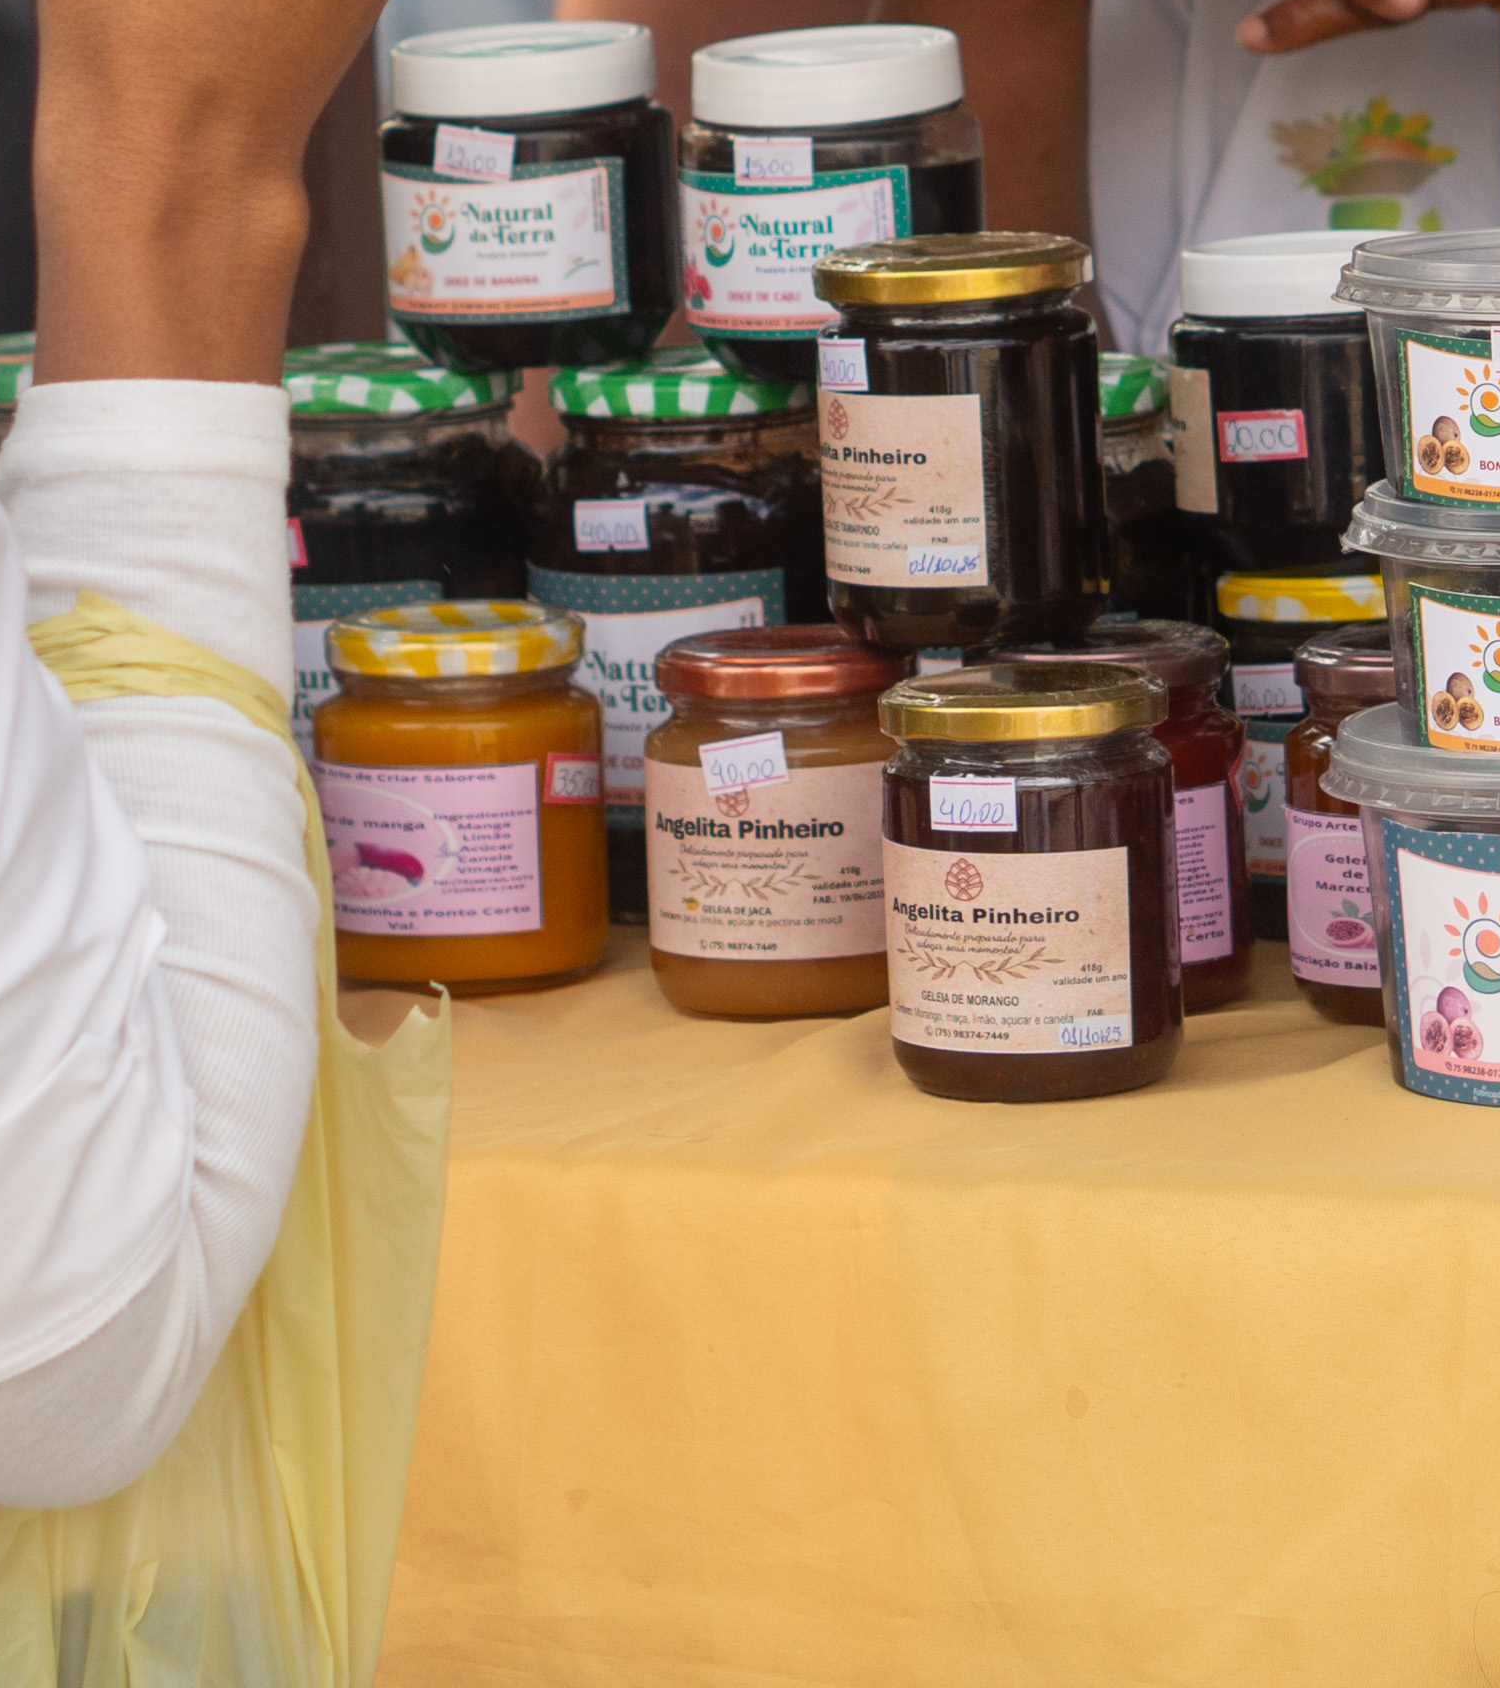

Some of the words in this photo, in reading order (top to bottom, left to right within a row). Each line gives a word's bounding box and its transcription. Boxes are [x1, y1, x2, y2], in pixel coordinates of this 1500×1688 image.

[741, 156, 794, 179] 15,00
[461, 202, 553, 224] Natural
[740, 214, 834, 236] Natural
[470, 228, 487, 242] da
[491, 225, 555, 245] Terra
[749, 243, 766, 257] da
[842, 447, 927, 465] Pinheiro
[424, 773, 496, 782] Sabores
[710, 759, 774, 785] 40,00
[940, 798, 1005, 828] 40,00
[363, 820, 425, 831] manga
[656, 812, 731, 840] Angelita
[739, 819, 844, 839] Pinheiro
[1326, 821, 1357, 831] Arte
[1325, 853, 1366, 865] Gelei
[1342, 869, 1363, 879] de
[483, 904, 530, 915] Certo
[734, 907, 746, 915] DE
[748, 907, 772, 917] JACA
[893, 897, 964, 923] Angelita
[973, 908, 1080, 924] Pinheiro
[964, 932, 1018, 944] preparado
[1020, 934, 1046, 943] para
[1186, 929, 1224, 943] Certo
[1081, 964, 1103, 973] 418g
[1053, 976, 1093, 986] validade
[1112, 973, 1127, 981] ano
[921, 990, 949, 1003] GELEIA
[952, 994, 964, 1004] DE
[967, 995, 1019, 1006] MORANGO
[1043, 1015, 1074, 1024] canela
